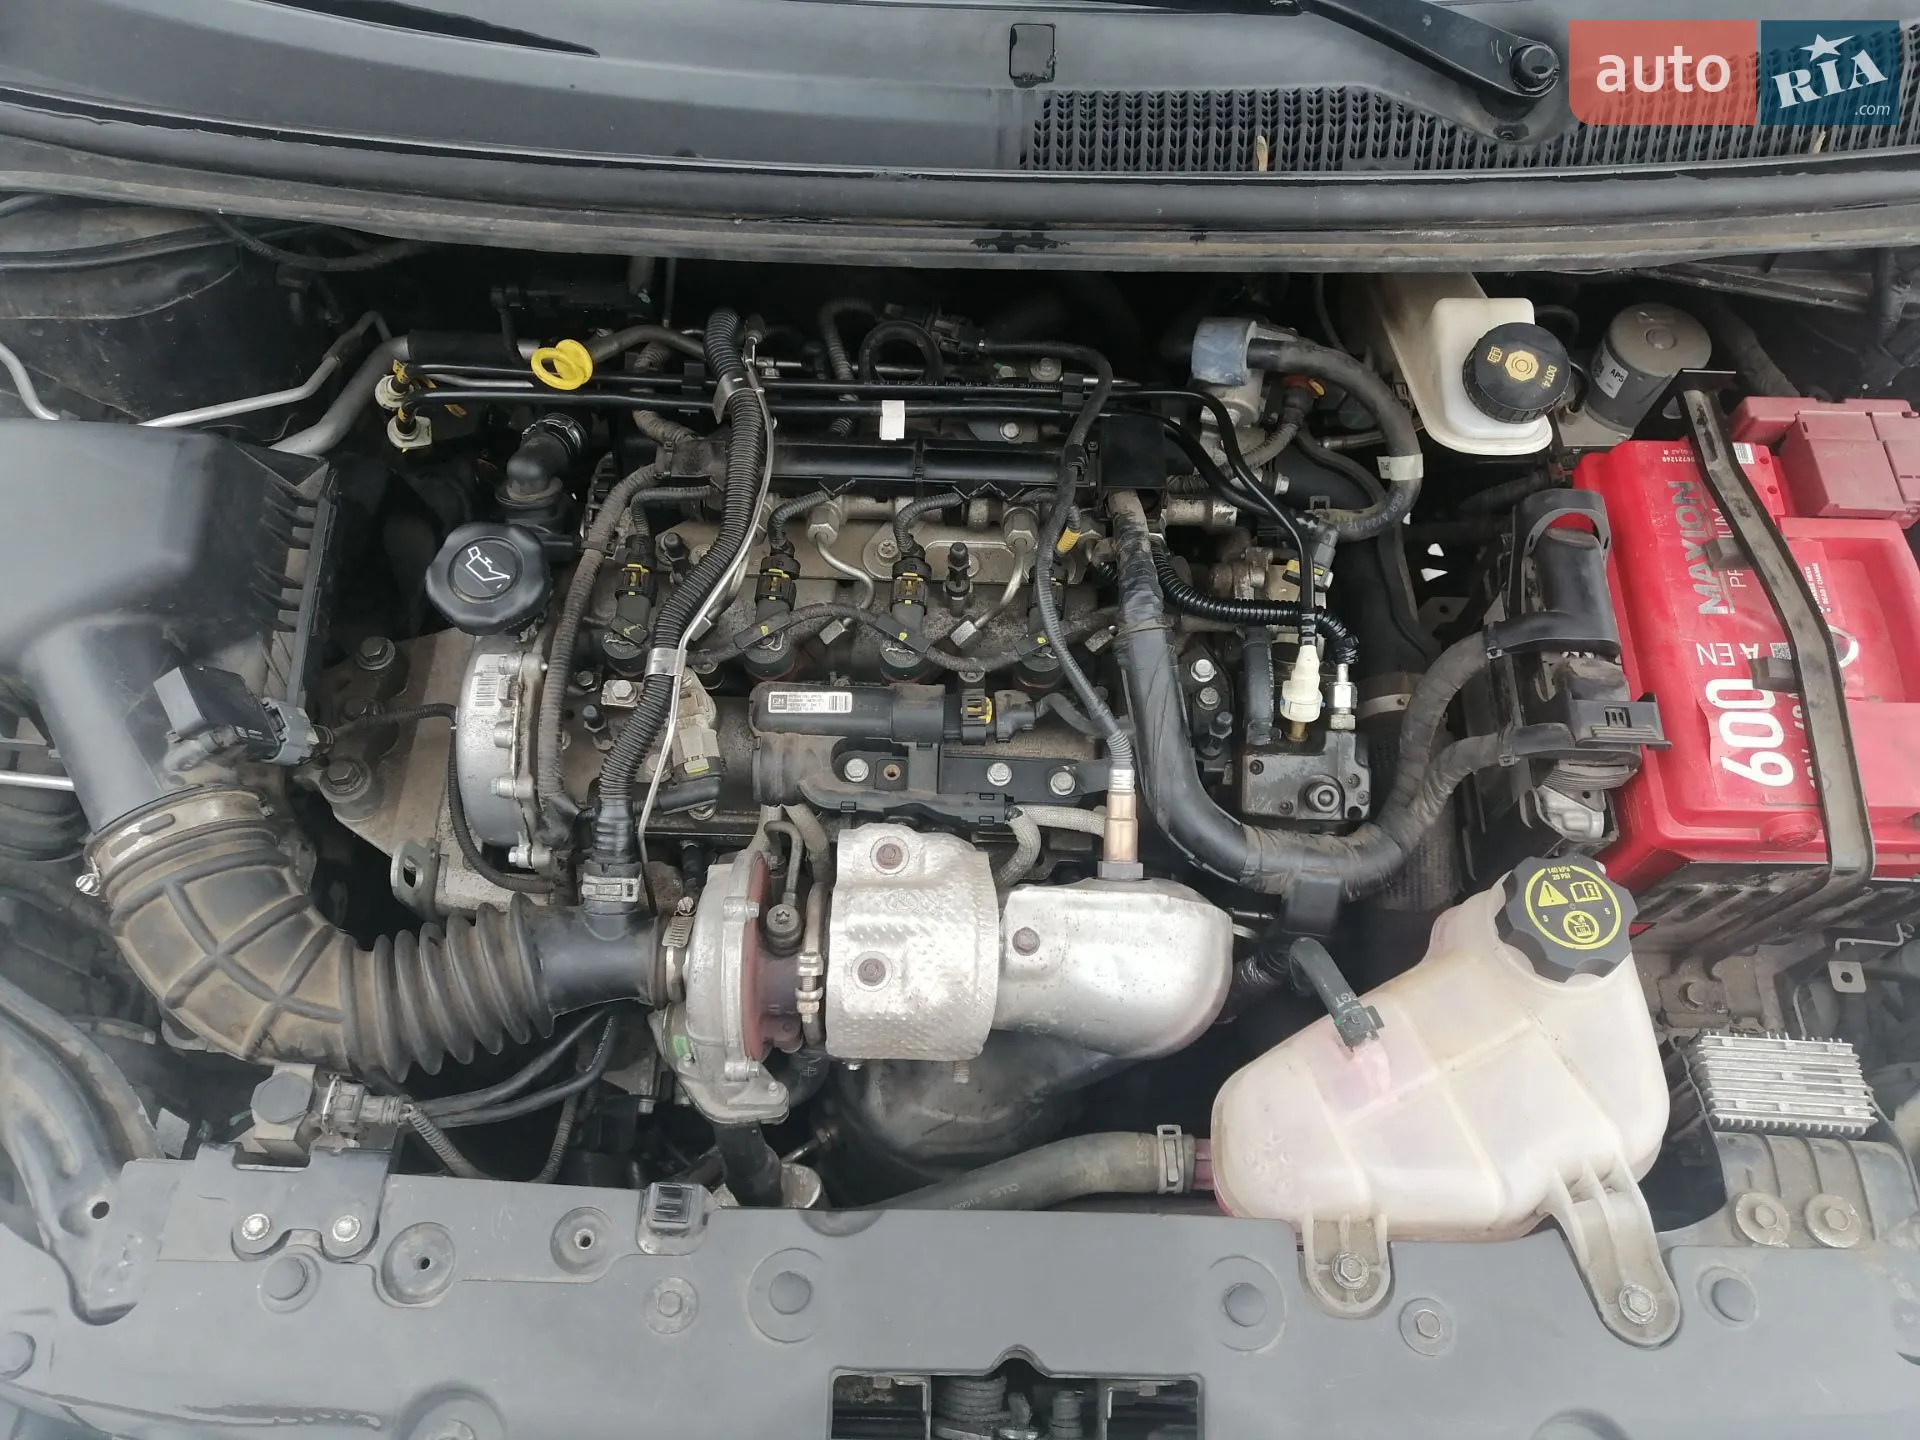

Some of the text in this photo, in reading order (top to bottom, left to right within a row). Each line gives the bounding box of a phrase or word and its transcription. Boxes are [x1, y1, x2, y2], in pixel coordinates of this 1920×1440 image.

[1544, 364, 1559, 383] DOT
[1667, 480, 1731, 614] MAXION
[1811, 562, 1824, 585] CHANGE
[1695, 642, 1759, 666] A EN
[1705, 678, 1794, 787] 600
